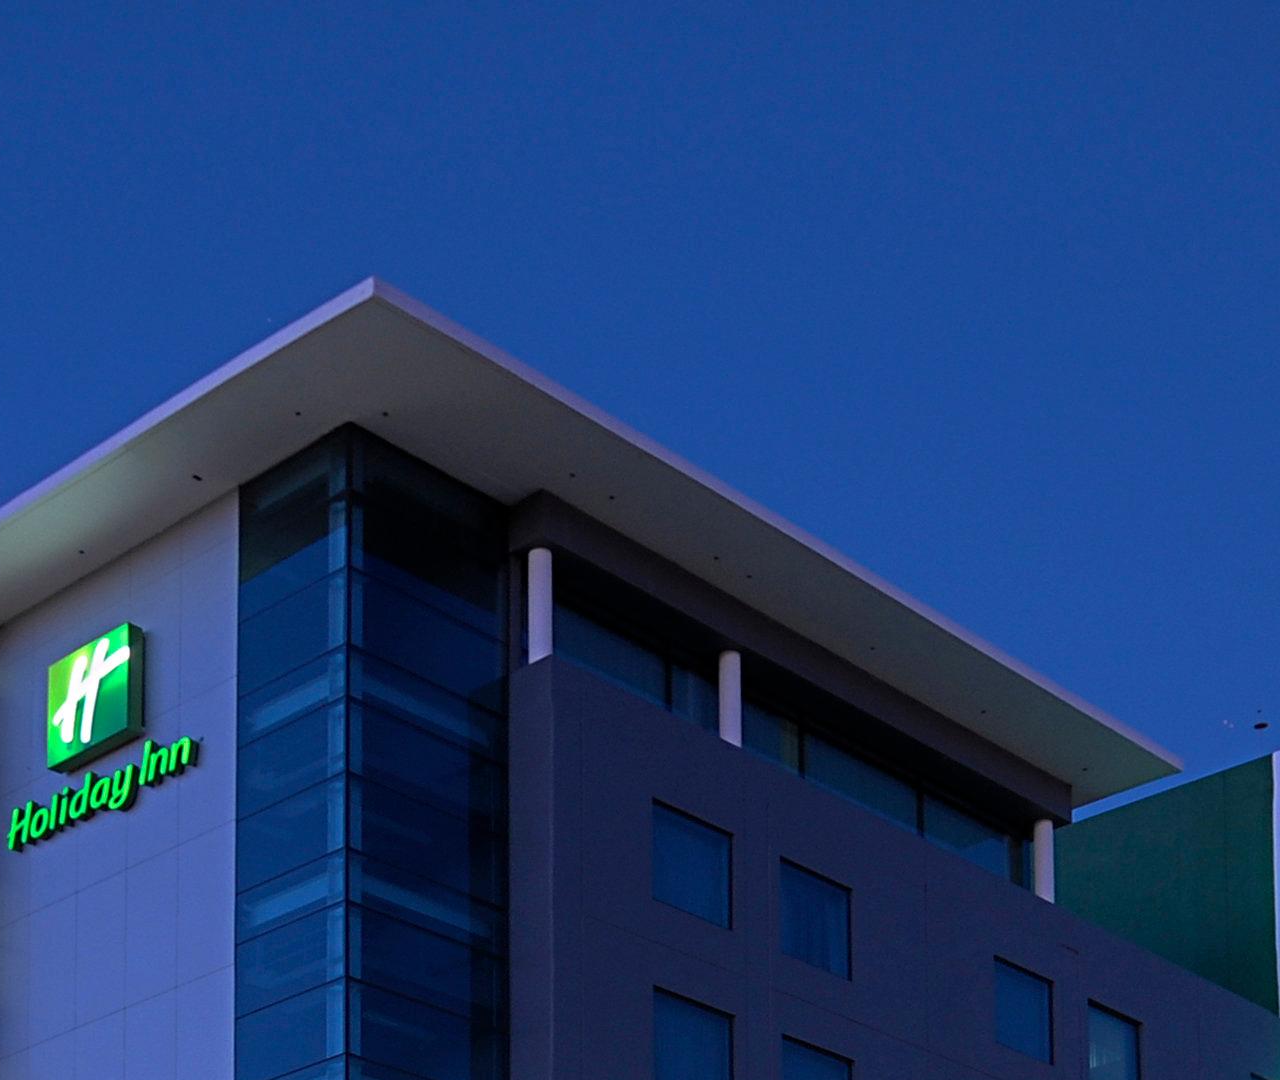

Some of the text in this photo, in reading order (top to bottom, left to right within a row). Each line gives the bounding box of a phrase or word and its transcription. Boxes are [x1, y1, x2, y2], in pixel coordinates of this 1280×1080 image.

[52, 638, 131, 744] H
[7, 736, 192, 850] Holiday Inn
